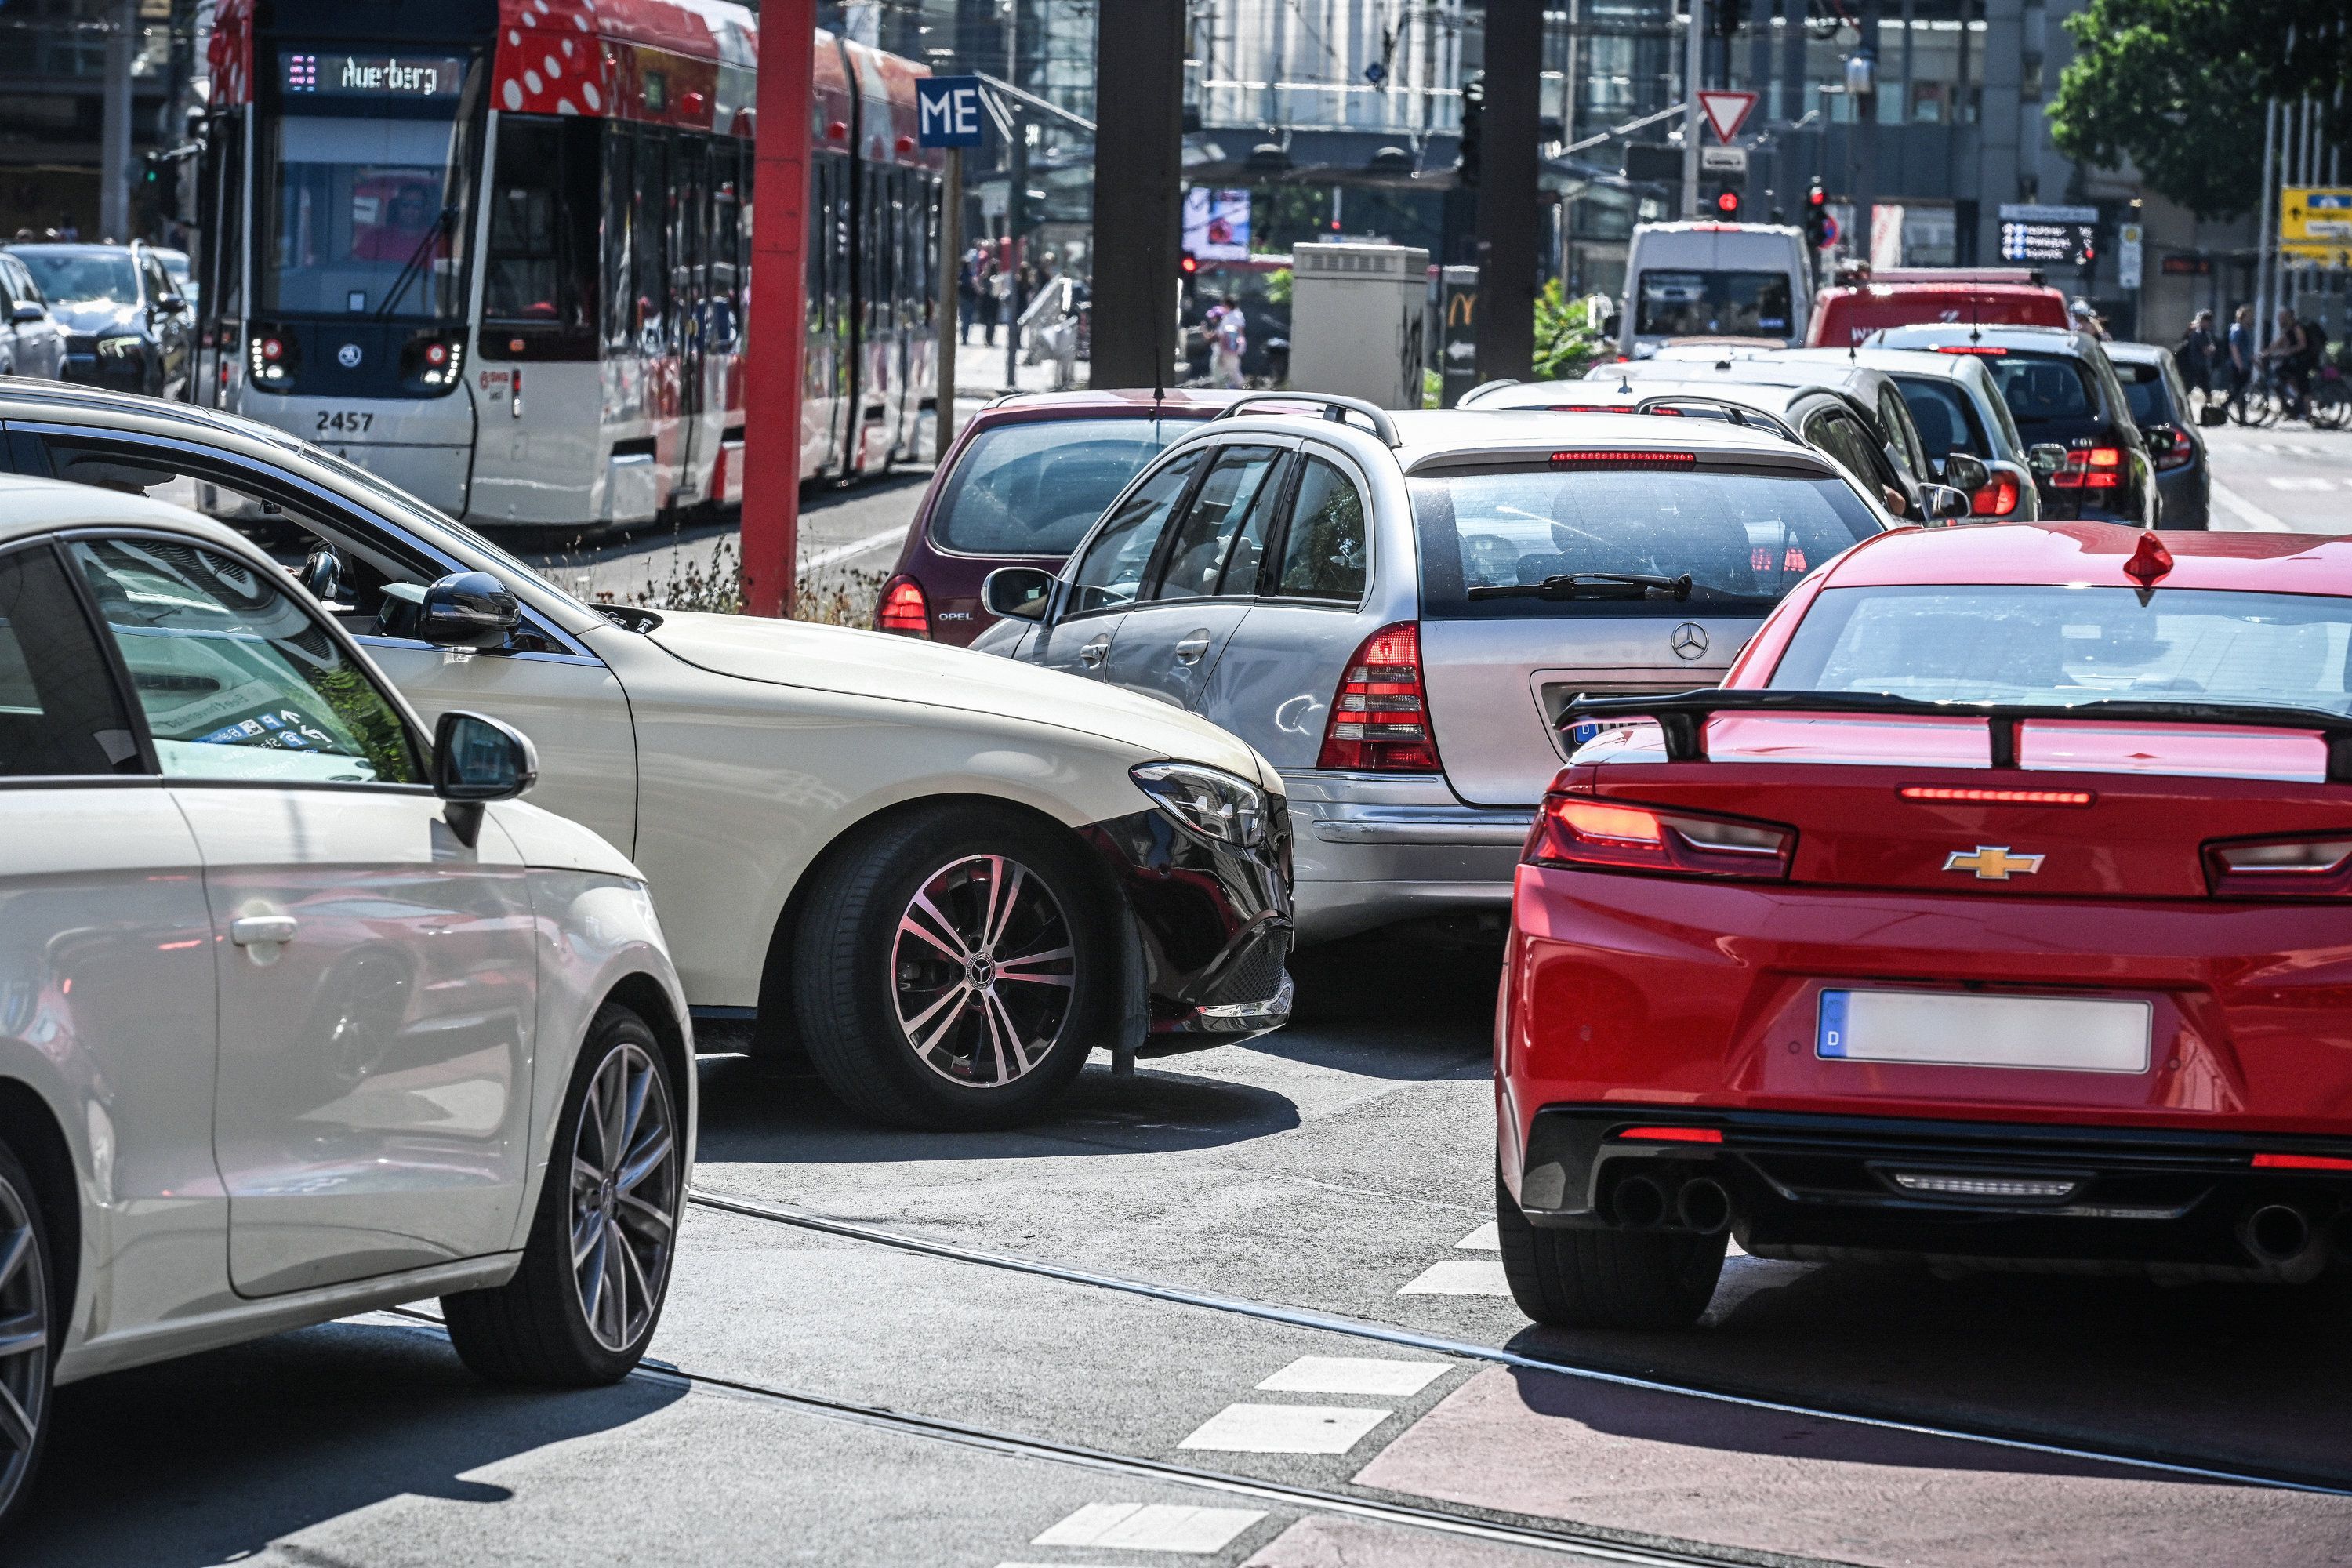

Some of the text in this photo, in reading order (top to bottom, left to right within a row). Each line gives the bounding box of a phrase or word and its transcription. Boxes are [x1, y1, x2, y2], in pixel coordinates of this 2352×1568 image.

[920, 89, 977, 134] ME
[316, 411, 374, 431] 2457
[938, 612, 974, 621] OPEL
[1828, 1031, 1839, 1046] D
